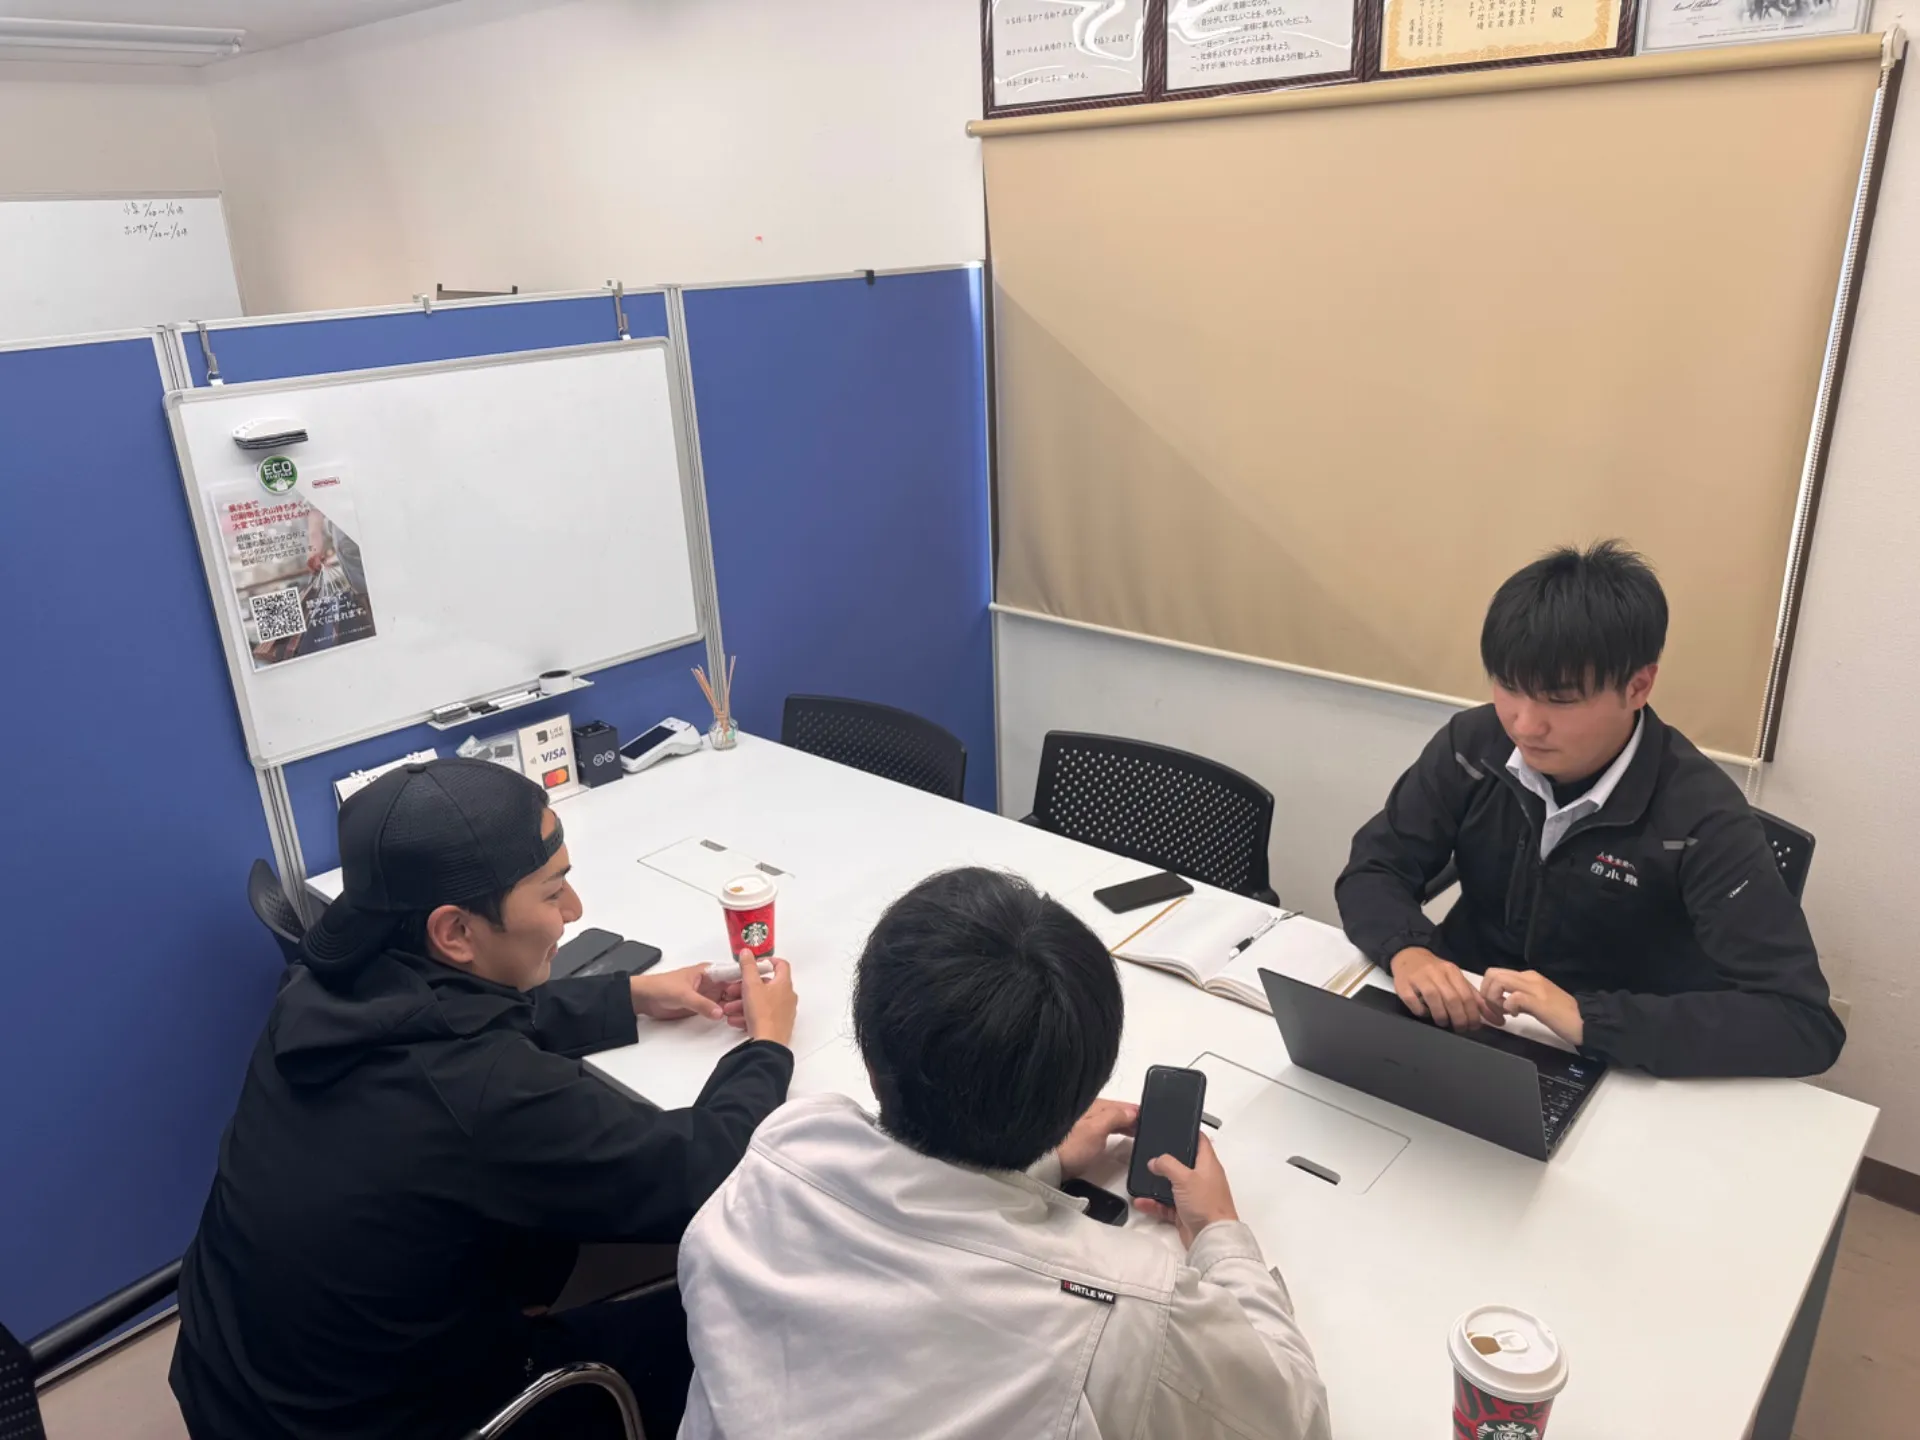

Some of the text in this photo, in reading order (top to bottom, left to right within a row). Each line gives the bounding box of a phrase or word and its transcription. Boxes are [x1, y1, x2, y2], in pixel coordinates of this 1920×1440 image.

[1551, 6, 1564, 19] 殿
[263, 460, 292, 475] ECO
[541, 747, 567, 763] VISA
